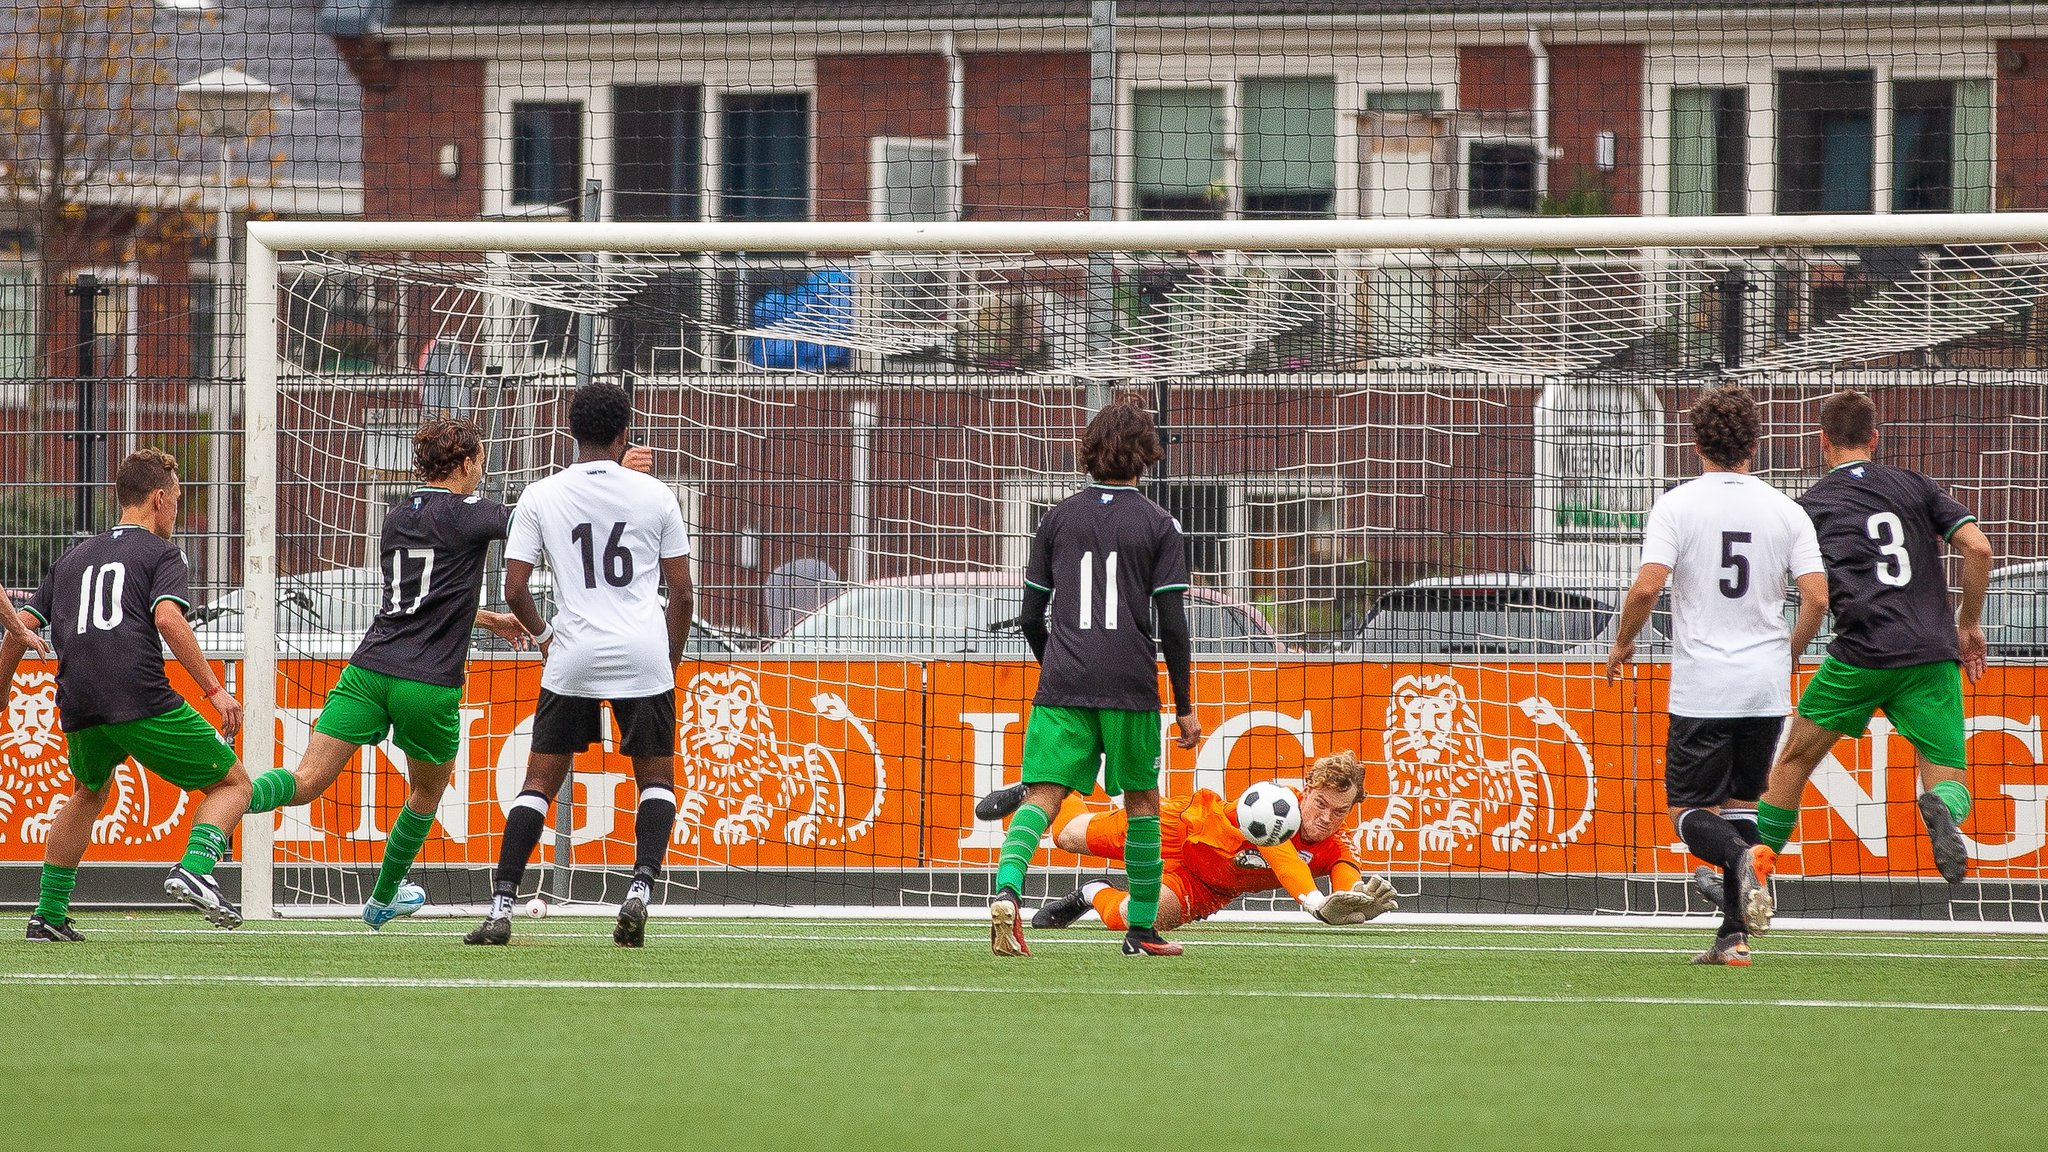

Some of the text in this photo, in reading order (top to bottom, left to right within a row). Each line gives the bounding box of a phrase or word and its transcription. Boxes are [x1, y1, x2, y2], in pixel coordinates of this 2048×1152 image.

[386, 548, 435, 615] 17
[571, 521, 634, 589] 16
[1719, 531, 1752, 599] 5
[1867, 512, 1912, 587] 3
[77, 561, 126, 635] 10
[1079, 551, 1118, 630] 11
